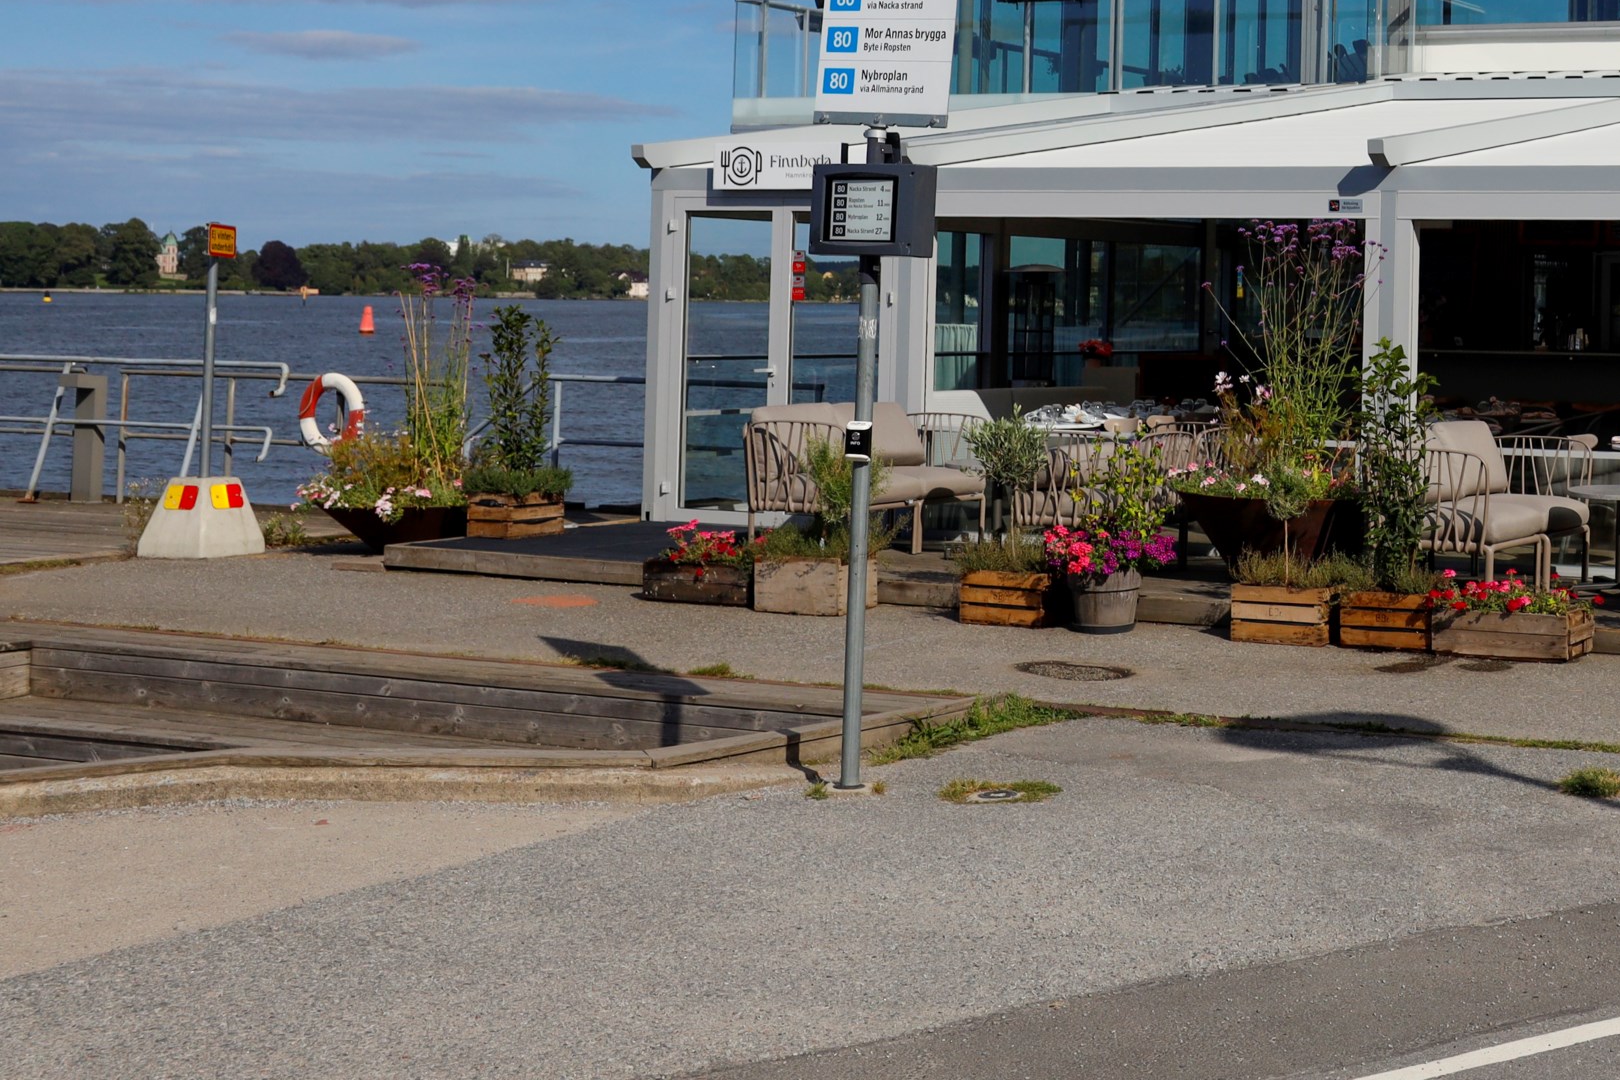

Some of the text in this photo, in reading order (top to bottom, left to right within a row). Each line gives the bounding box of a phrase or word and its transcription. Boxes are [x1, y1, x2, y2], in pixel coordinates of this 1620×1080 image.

[867, 1, 924, 9] via Nacka strand
[833, 28, 947, 48] 80 Mor Annas brygga
[863, 42, 879, 52] Byte
[883, 43, 911, 52] Ropsten
[829, 69, 908, 89] 80 Nybroplan
[860, 85, 924, 95] via Allmänna gränd
[770, 154, 832, 168] Finnboda
[837, 184, 846, 193] 80
[836, 199, 845, 207] 80
[877, 199, 884, 207] 11
[835, 213, 844, 221] 80
[876, 213, 883, 221] 12
[834, 227, 843, 235] 80
[875, 227, 883, 235] 27
